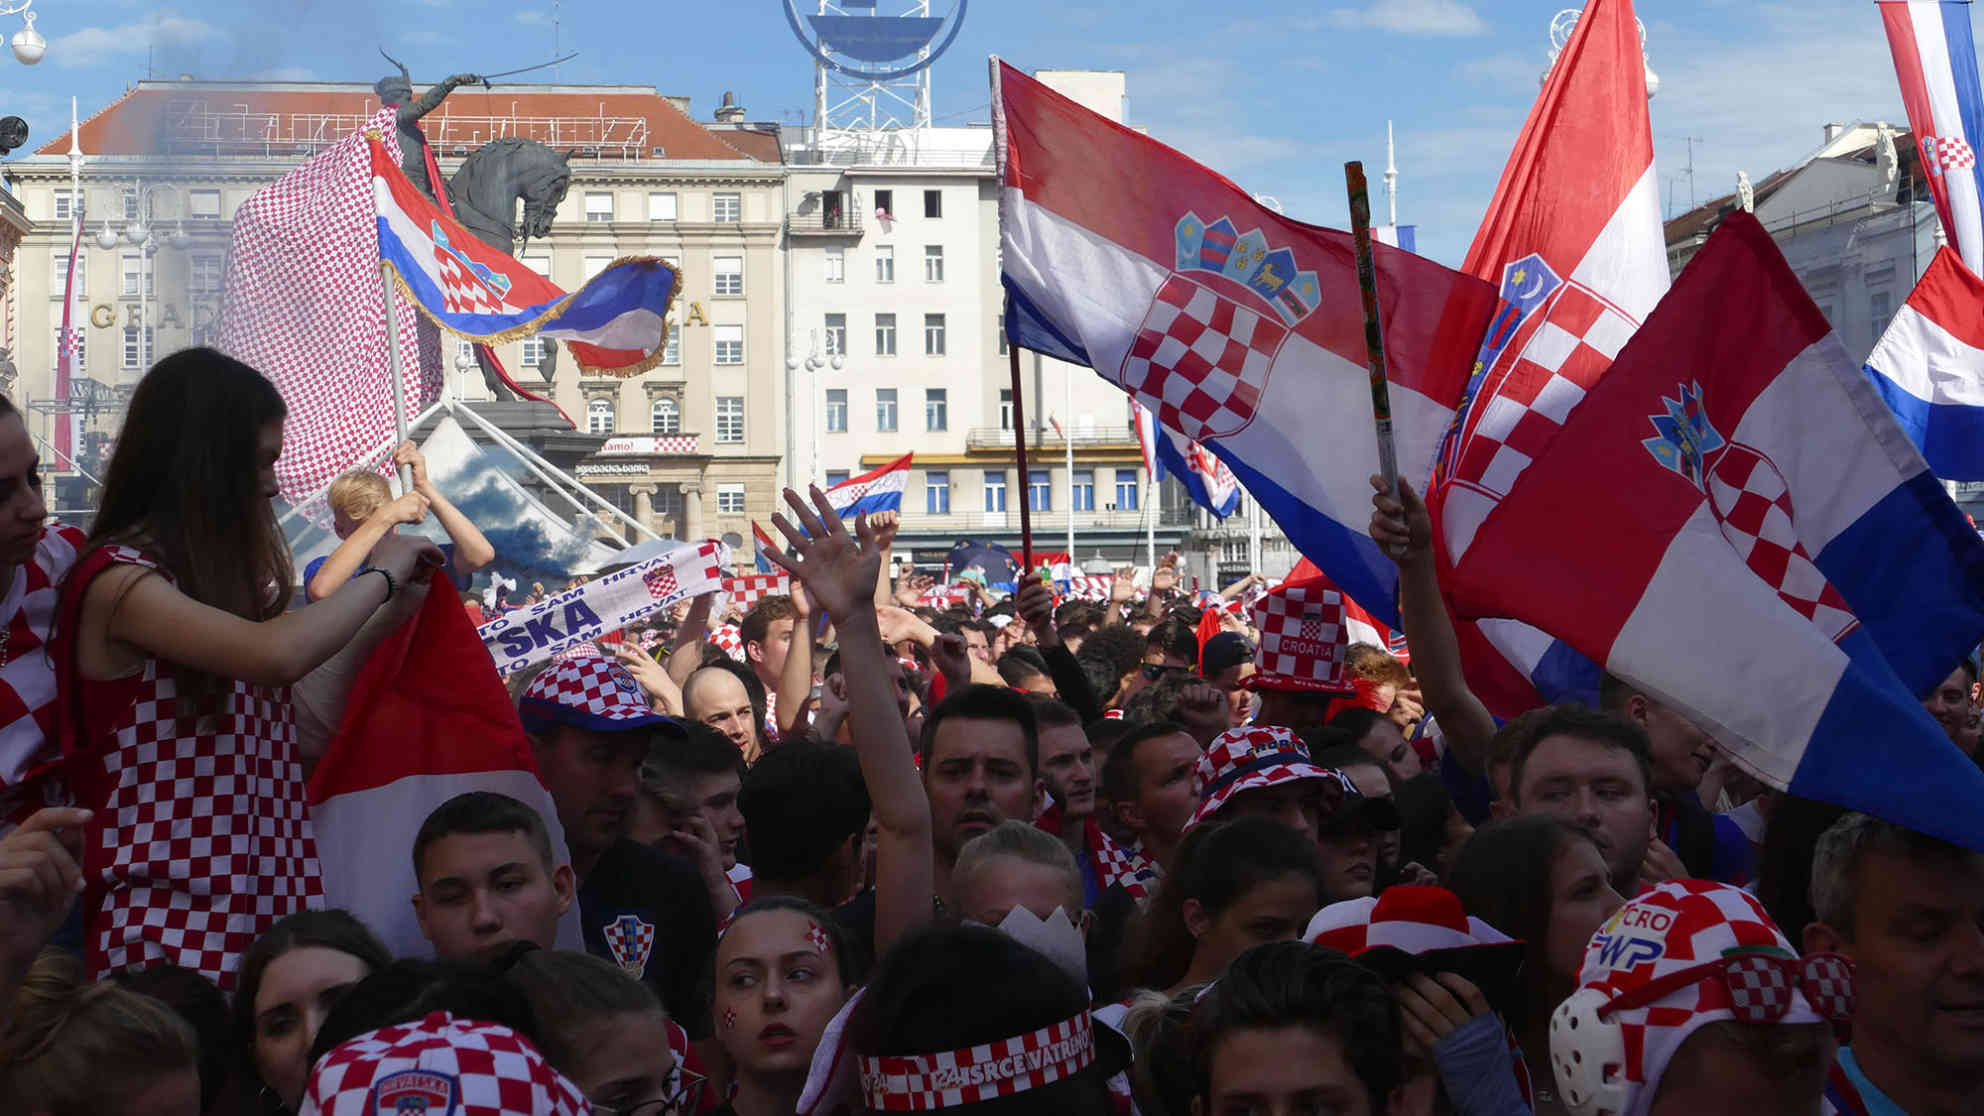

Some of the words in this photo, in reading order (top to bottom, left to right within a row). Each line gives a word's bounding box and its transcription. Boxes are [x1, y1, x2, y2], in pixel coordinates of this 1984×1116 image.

[530, 587, 585, 616] SAM
[602, 551, 674, 586] HRVAT
[549, 627, 603, 656] SAM
[619, 587, 688, 623] HRVAT
[1280, 639, 1334, 657] CROATIA
[1623, 907, 1672, 932] CRO
[969, 1054, 1027, 1086] SRCE
